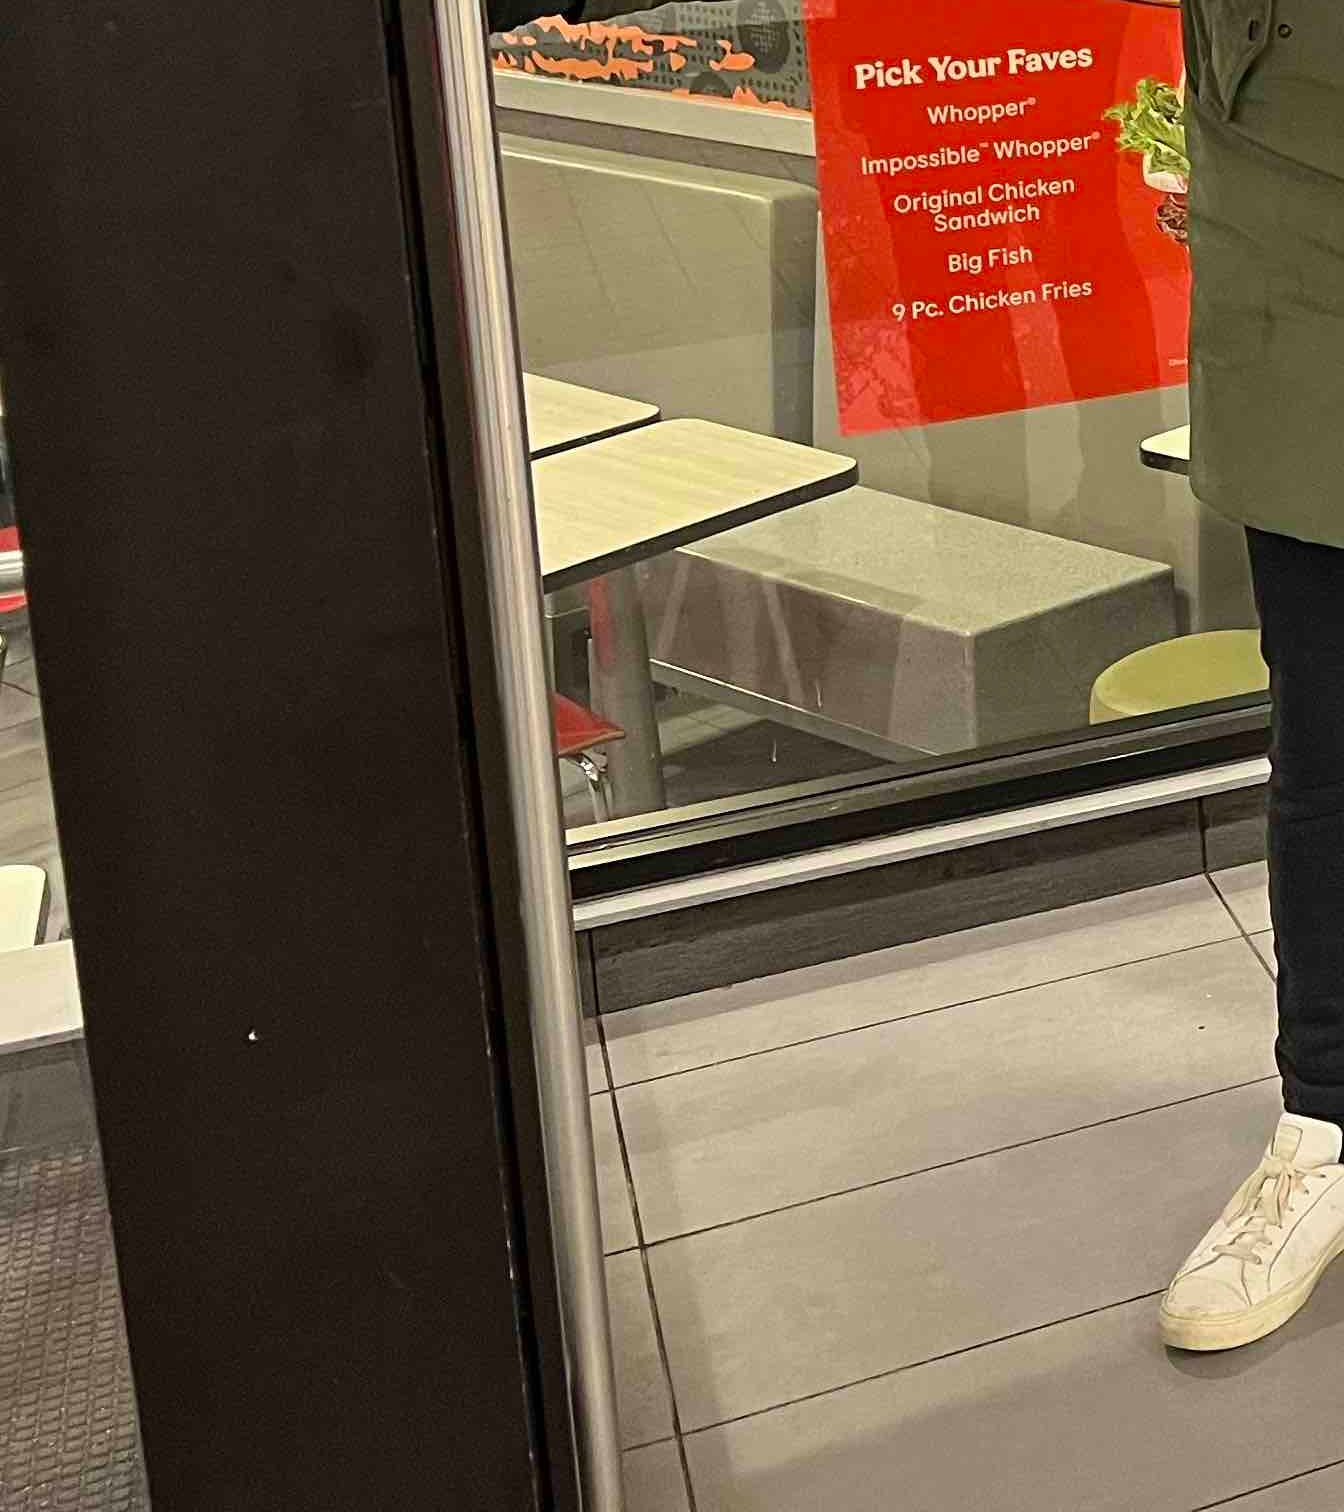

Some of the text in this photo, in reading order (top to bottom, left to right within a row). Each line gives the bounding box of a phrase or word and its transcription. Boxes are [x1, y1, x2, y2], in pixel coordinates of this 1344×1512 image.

[854, 47, 1094, 90] Pick Your Faves
[893, 178, 1076, 215] Original Chicken
[934, 203, 1041, 234] Sandwich
[947, 245, 1034, 276] Big Fish
[891, 280, 1094, 322] 9 Pc. Chicken Fries
